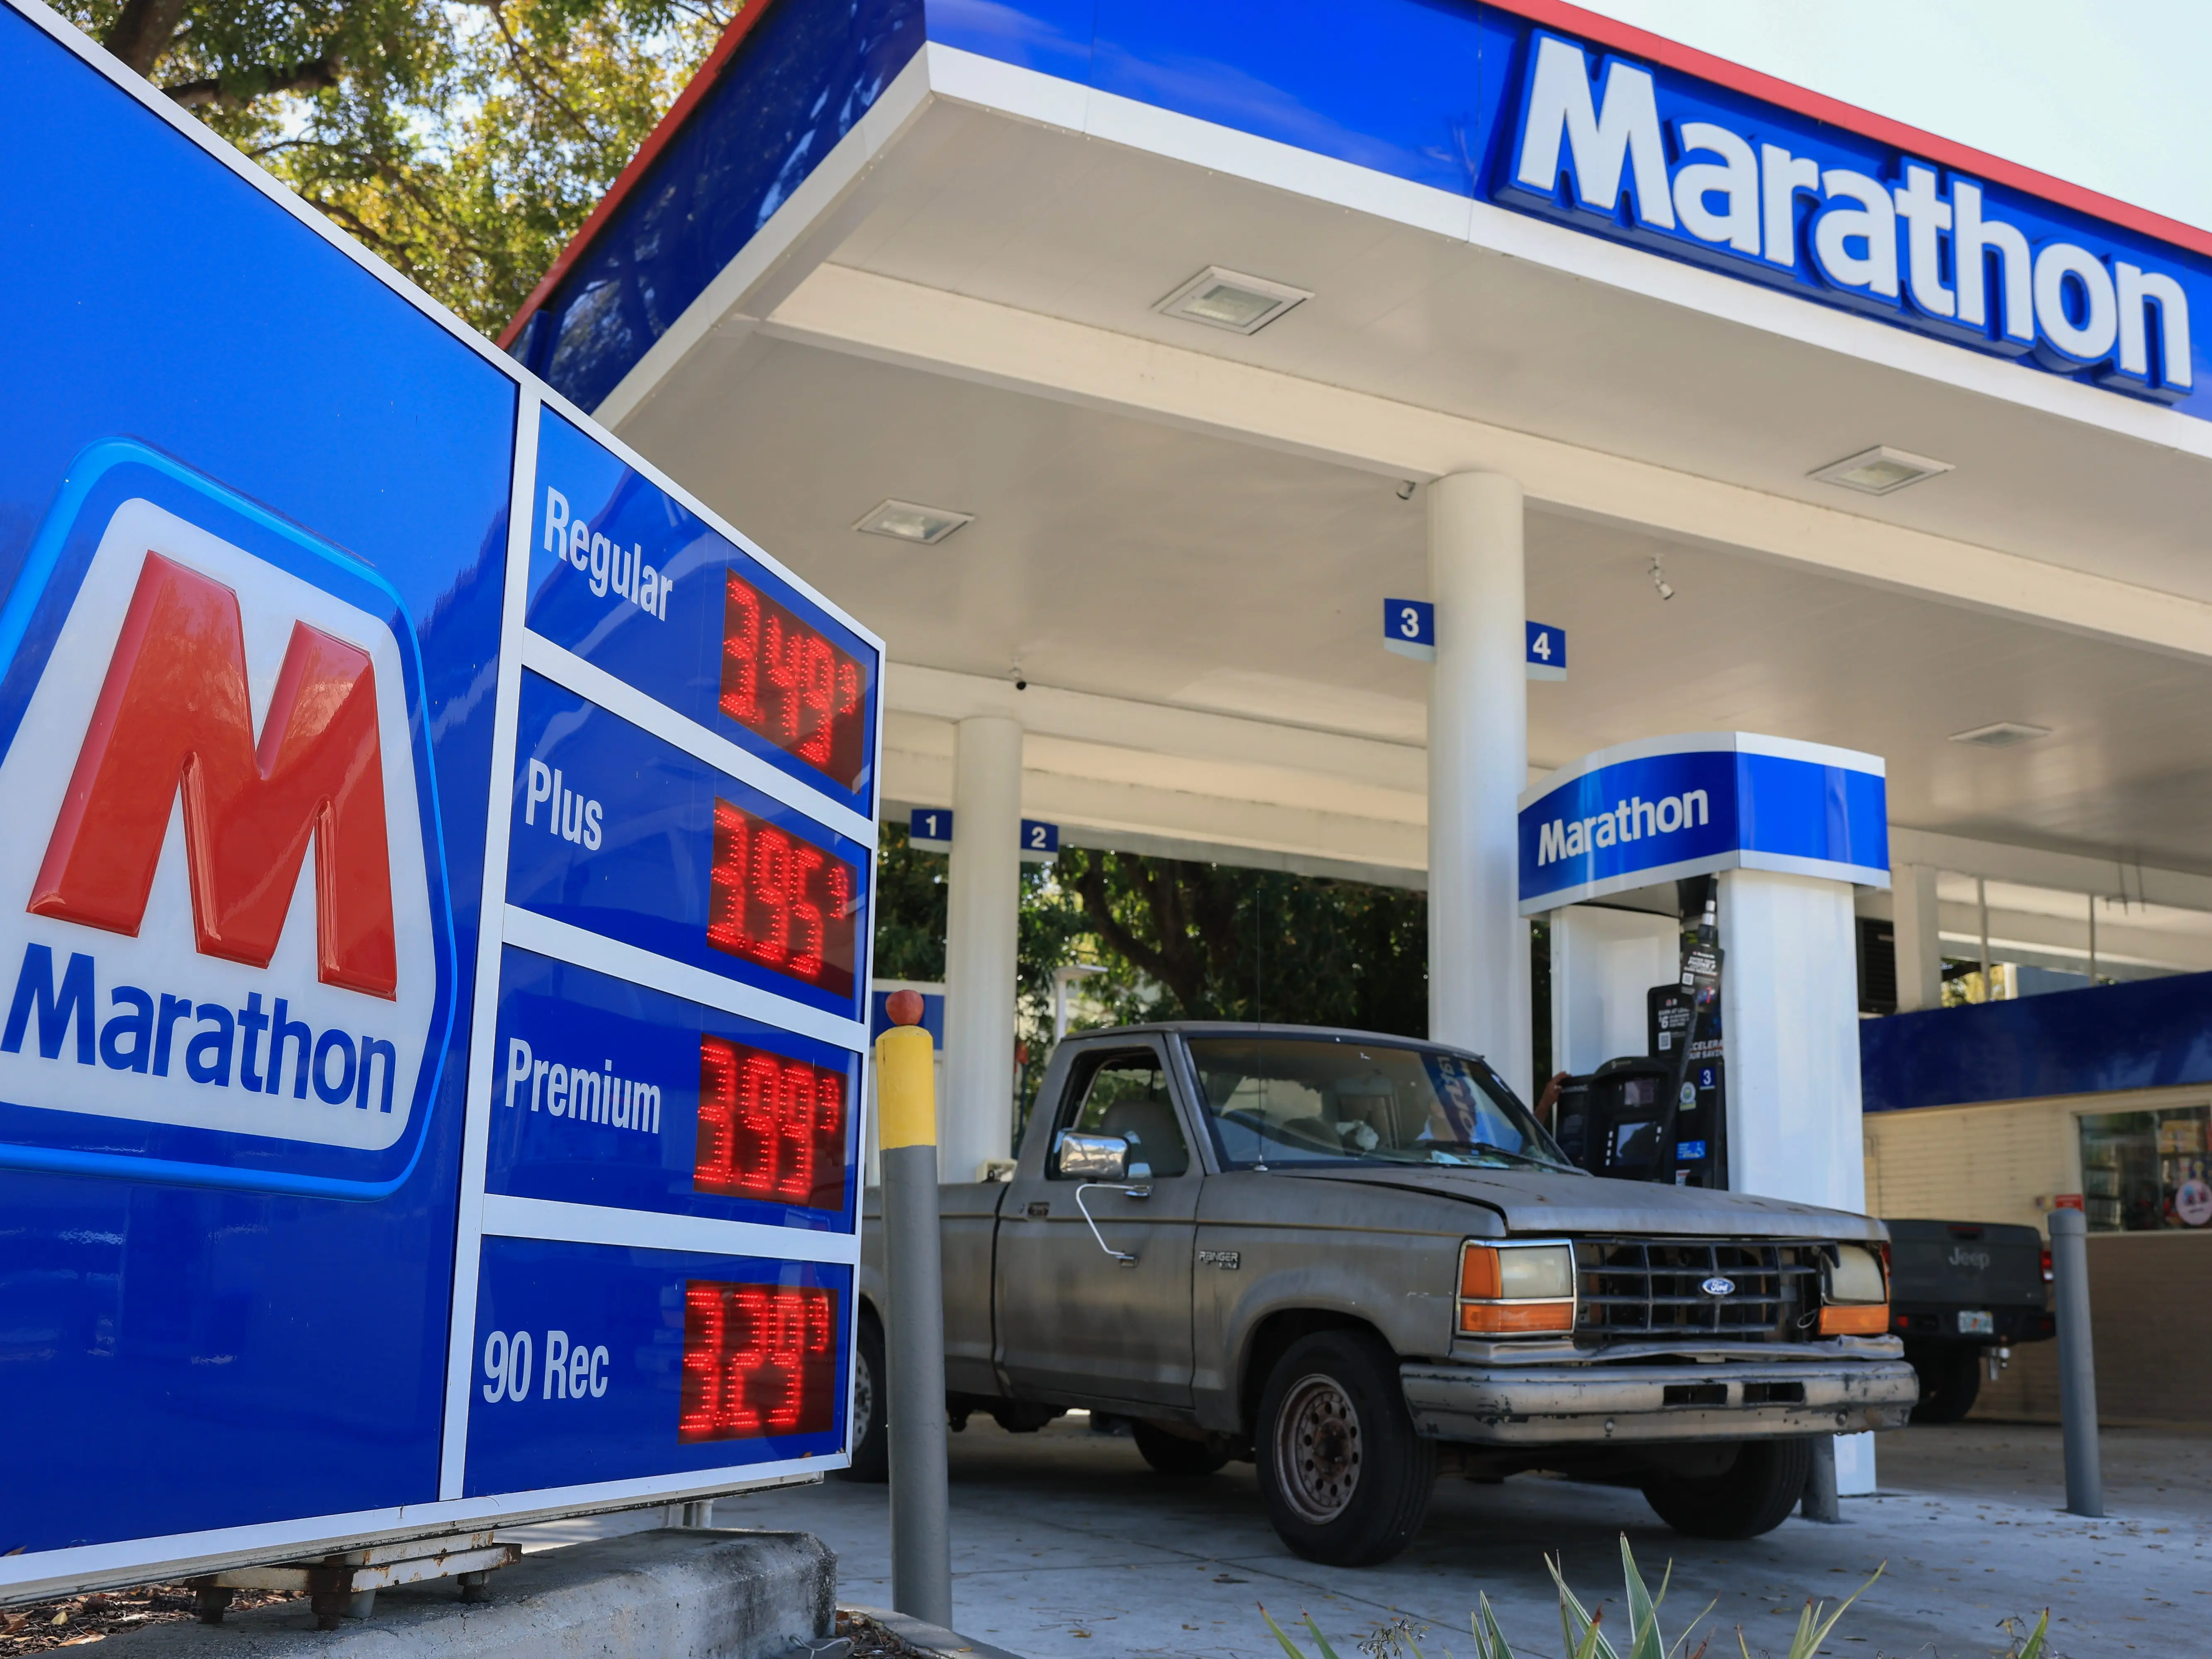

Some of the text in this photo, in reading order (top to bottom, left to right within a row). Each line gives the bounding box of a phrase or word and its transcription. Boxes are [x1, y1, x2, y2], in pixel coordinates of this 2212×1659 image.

[1517, 36, 2193, 387] Marathon
[544, 486, 672, 622] Regular
[1401, 608, 1419, 638] 3
[1533, 632, 1551, 660] 4
[26, 550, 397, 1002] M
[526, 758, 603, 851] Plus
[925, 815, 937, 837] 1
[1031, 827, 1047, 848] 2
[1538, 789, 1708, 866] Marathon
[0, 942, 396, 1114] Marathon
[506, 1038, 660, 1134] Premium
[1703, 1069, 1711, 1085] 3
[1711, 1280, 1728, 1292] Ford
[1948, 1247, 1990, 1270] Jeep
[483, 1330, 609, 1403] 90 Rec
